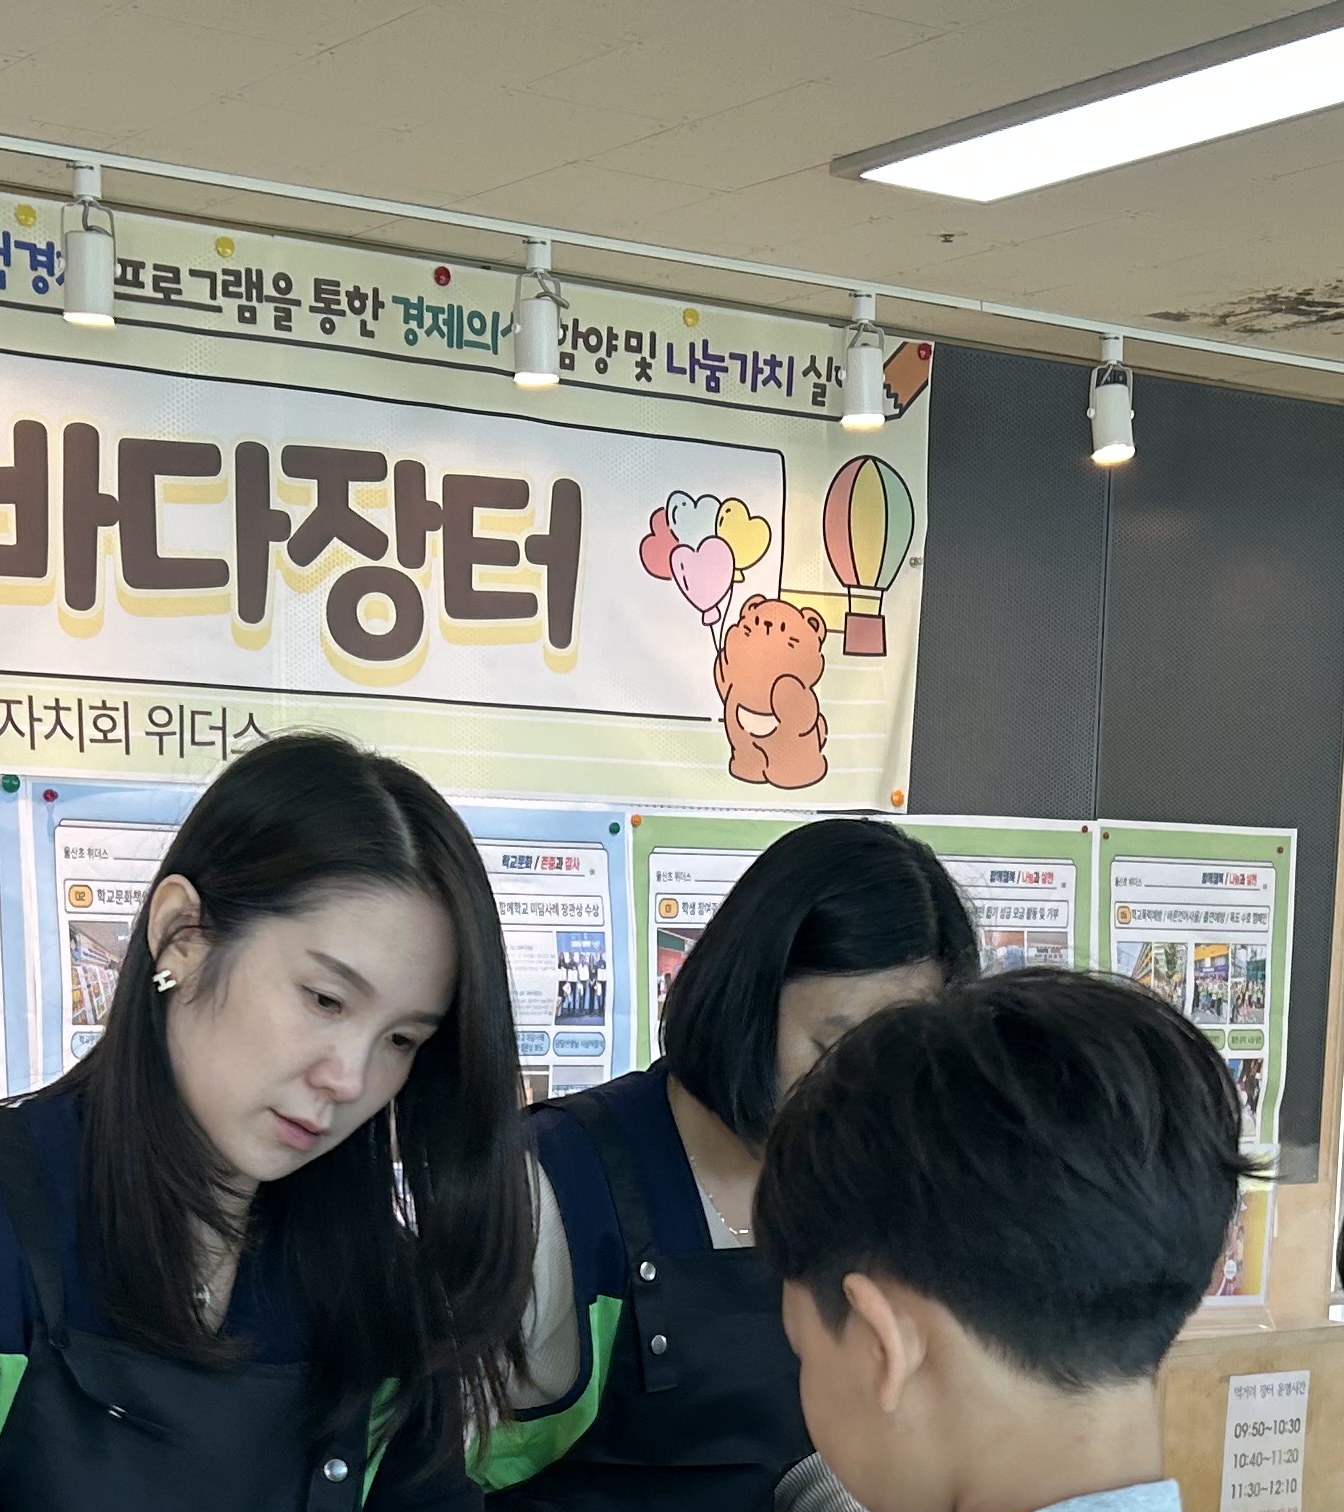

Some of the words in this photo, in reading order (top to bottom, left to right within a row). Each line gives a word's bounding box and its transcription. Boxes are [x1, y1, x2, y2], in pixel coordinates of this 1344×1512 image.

[114, 257, 302, 335] 프로그램을
[309, 276, 386, 338] 통한
[391, 294, 516, 356] 경제의
[558, 316, 618, 375] 함양
[623, 330, 658, 383] 및
[665, 339, 795, 397] 나눔가치
[145, 701, 272, 764] 위더스
[502, 854, 532, 869] 학교문화
[541, 856, 563, 870] 존중과
[565, 856, 580, 871] 감사
[585, 904, 599, 917] 수상
[1234, 1418, 1301, 1439] 09:50~10:30
[1233, 1448, 1299, 1469] 10:40~11:20
[1231, 1478, 1297, 1499] 11:30~12:10
